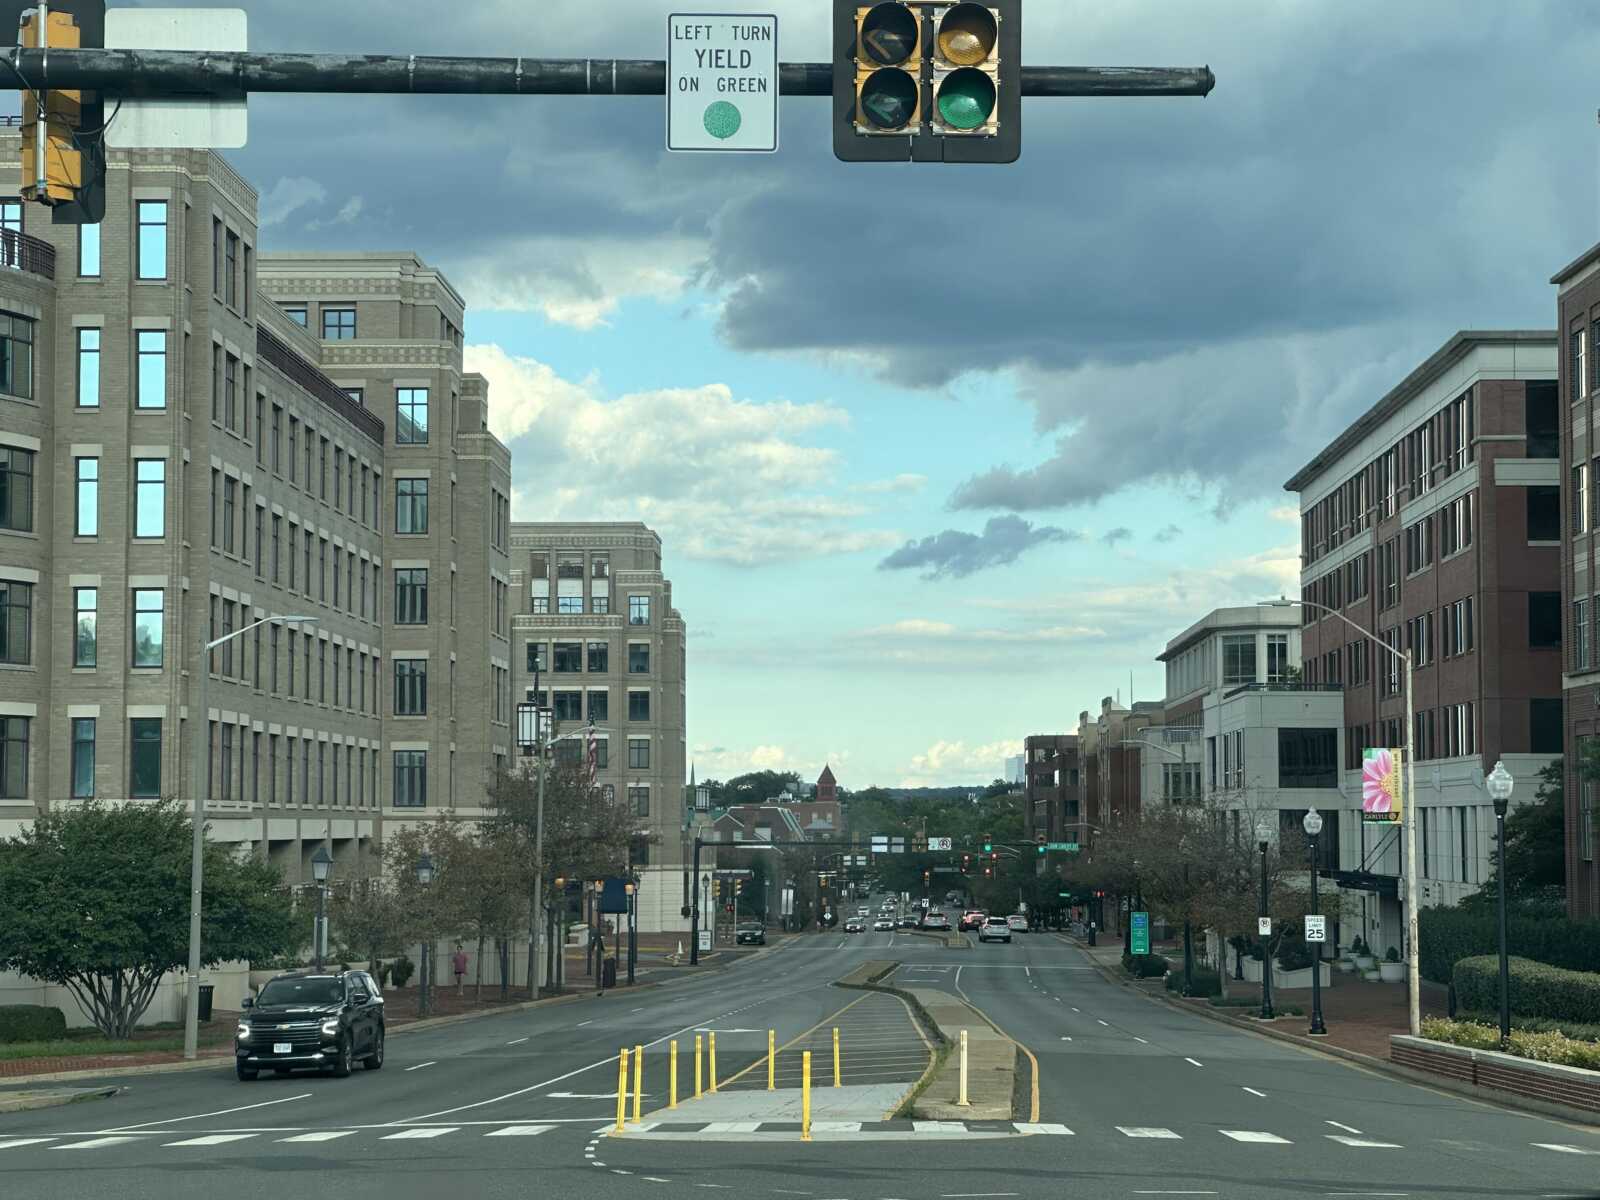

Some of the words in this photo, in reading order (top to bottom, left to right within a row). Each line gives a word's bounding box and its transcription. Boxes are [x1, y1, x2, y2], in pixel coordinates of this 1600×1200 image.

[675, 25, 712, 40] LEFT
[732, 26, 770, 41] TURN
[695, 49, 752, 69] YIELD
[679, 77, 699, 92] ON
[717, 77, 767, 93] GREEN
[1308, 929, 1324, 939] 25
